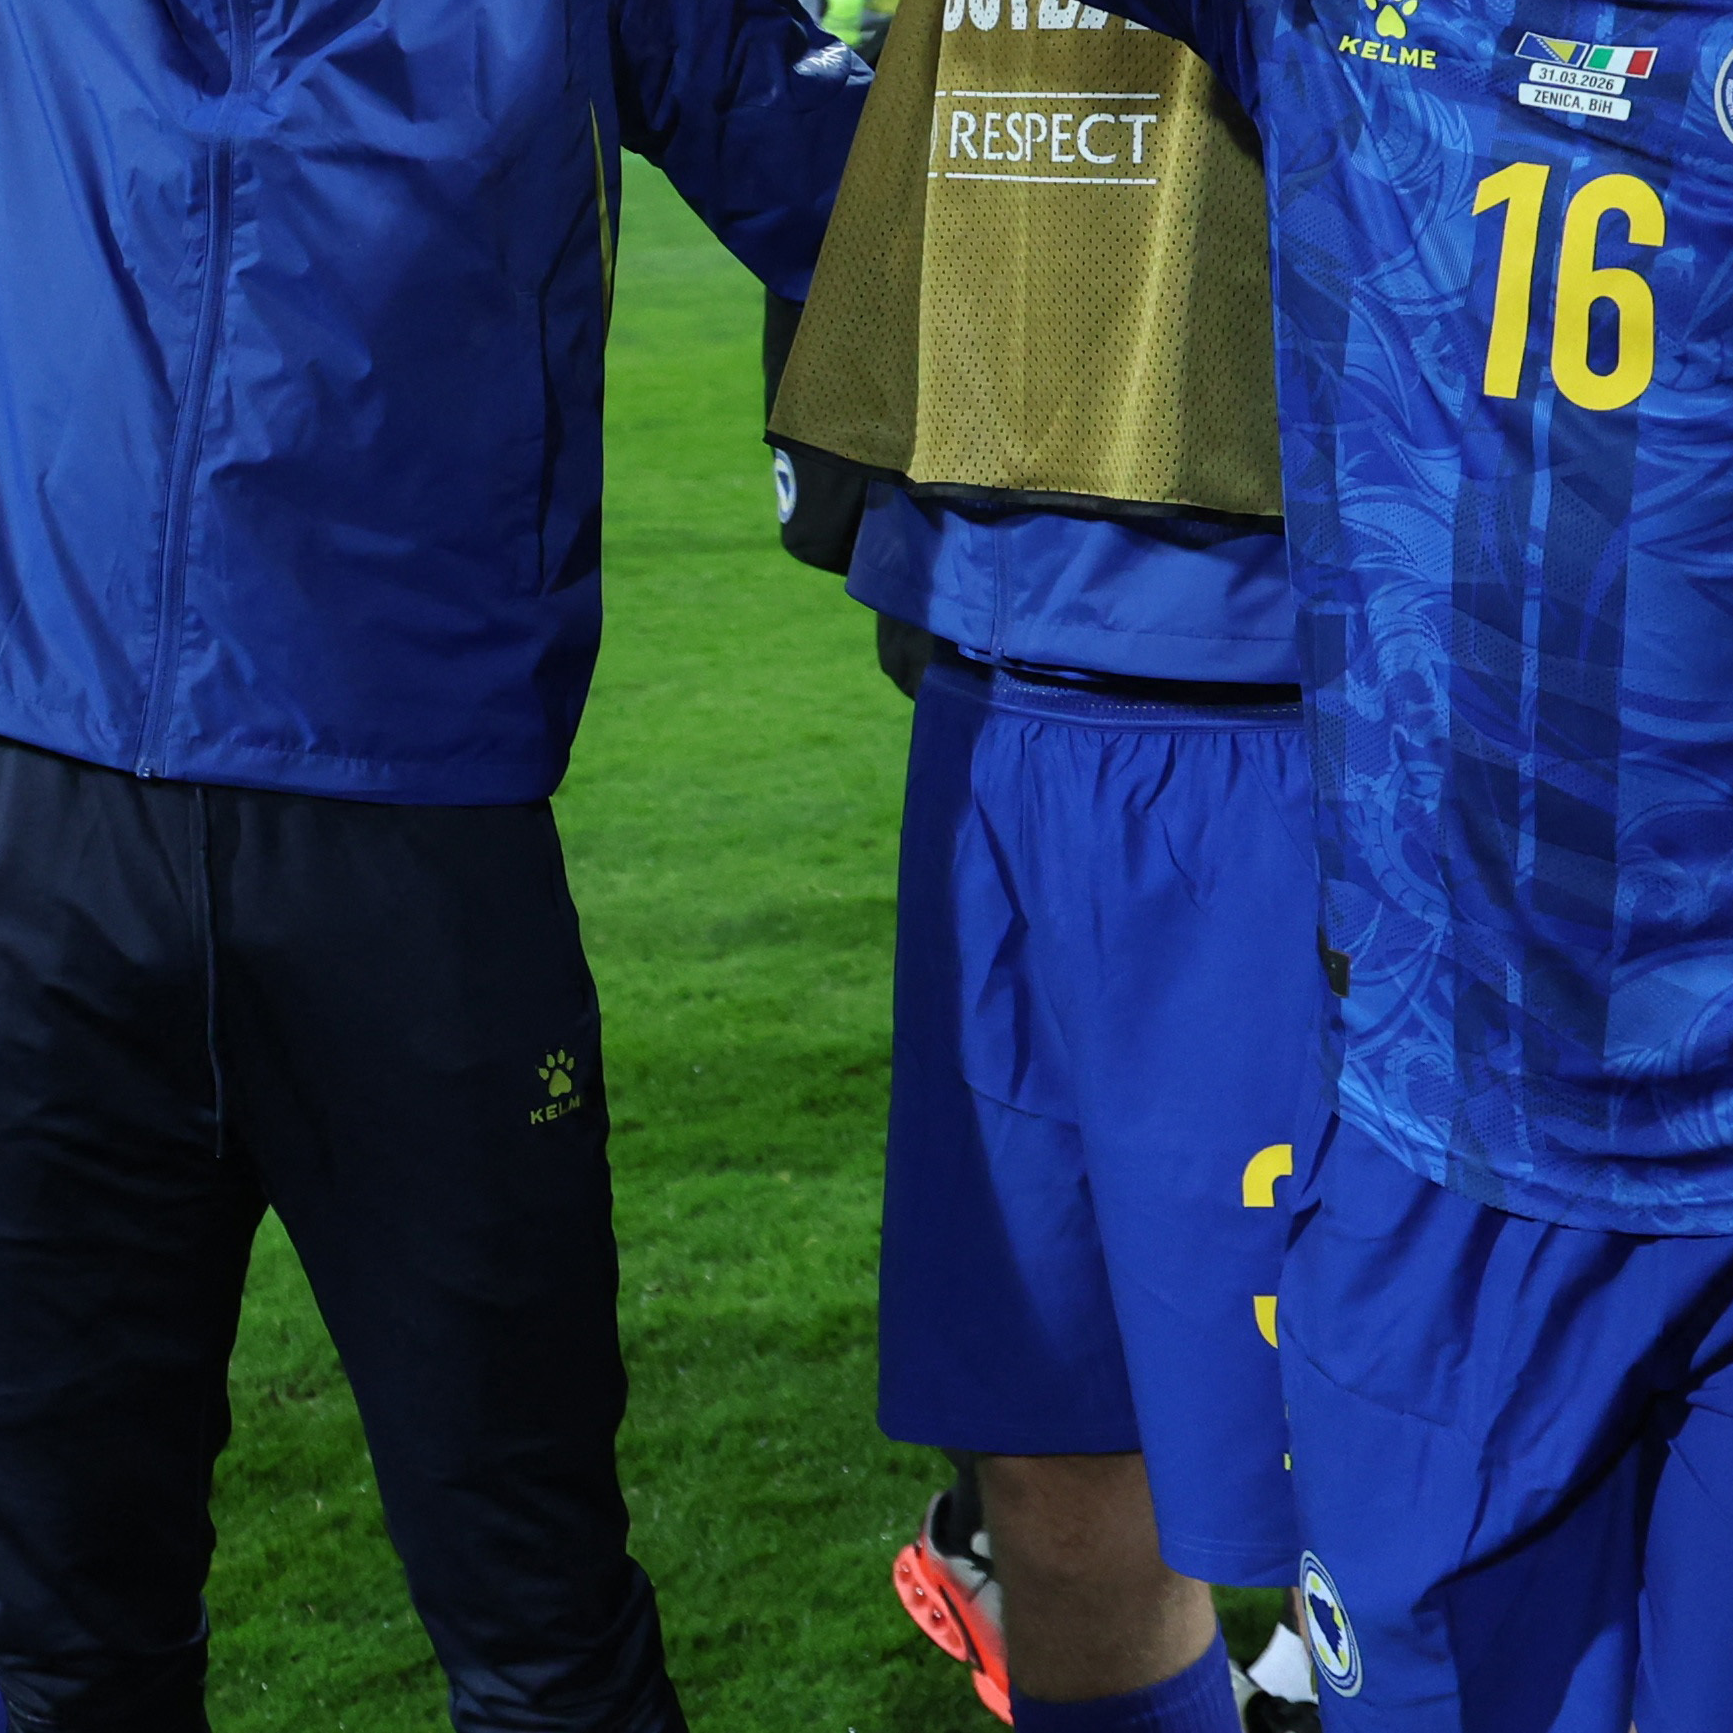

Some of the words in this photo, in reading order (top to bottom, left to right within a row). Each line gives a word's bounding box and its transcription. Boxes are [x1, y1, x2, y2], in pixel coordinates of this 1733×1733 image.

[1338, 35, 1437, 70] KELME
[1538, 67, 1615, 91] 31.03.2026
[1533, 89, 1585, 111] ZENICA,
[1589, 99, 1613, 114] BiH
[949, 111, 1157, 166] RESPECT
[1471, 161, 1666, 411] 16
